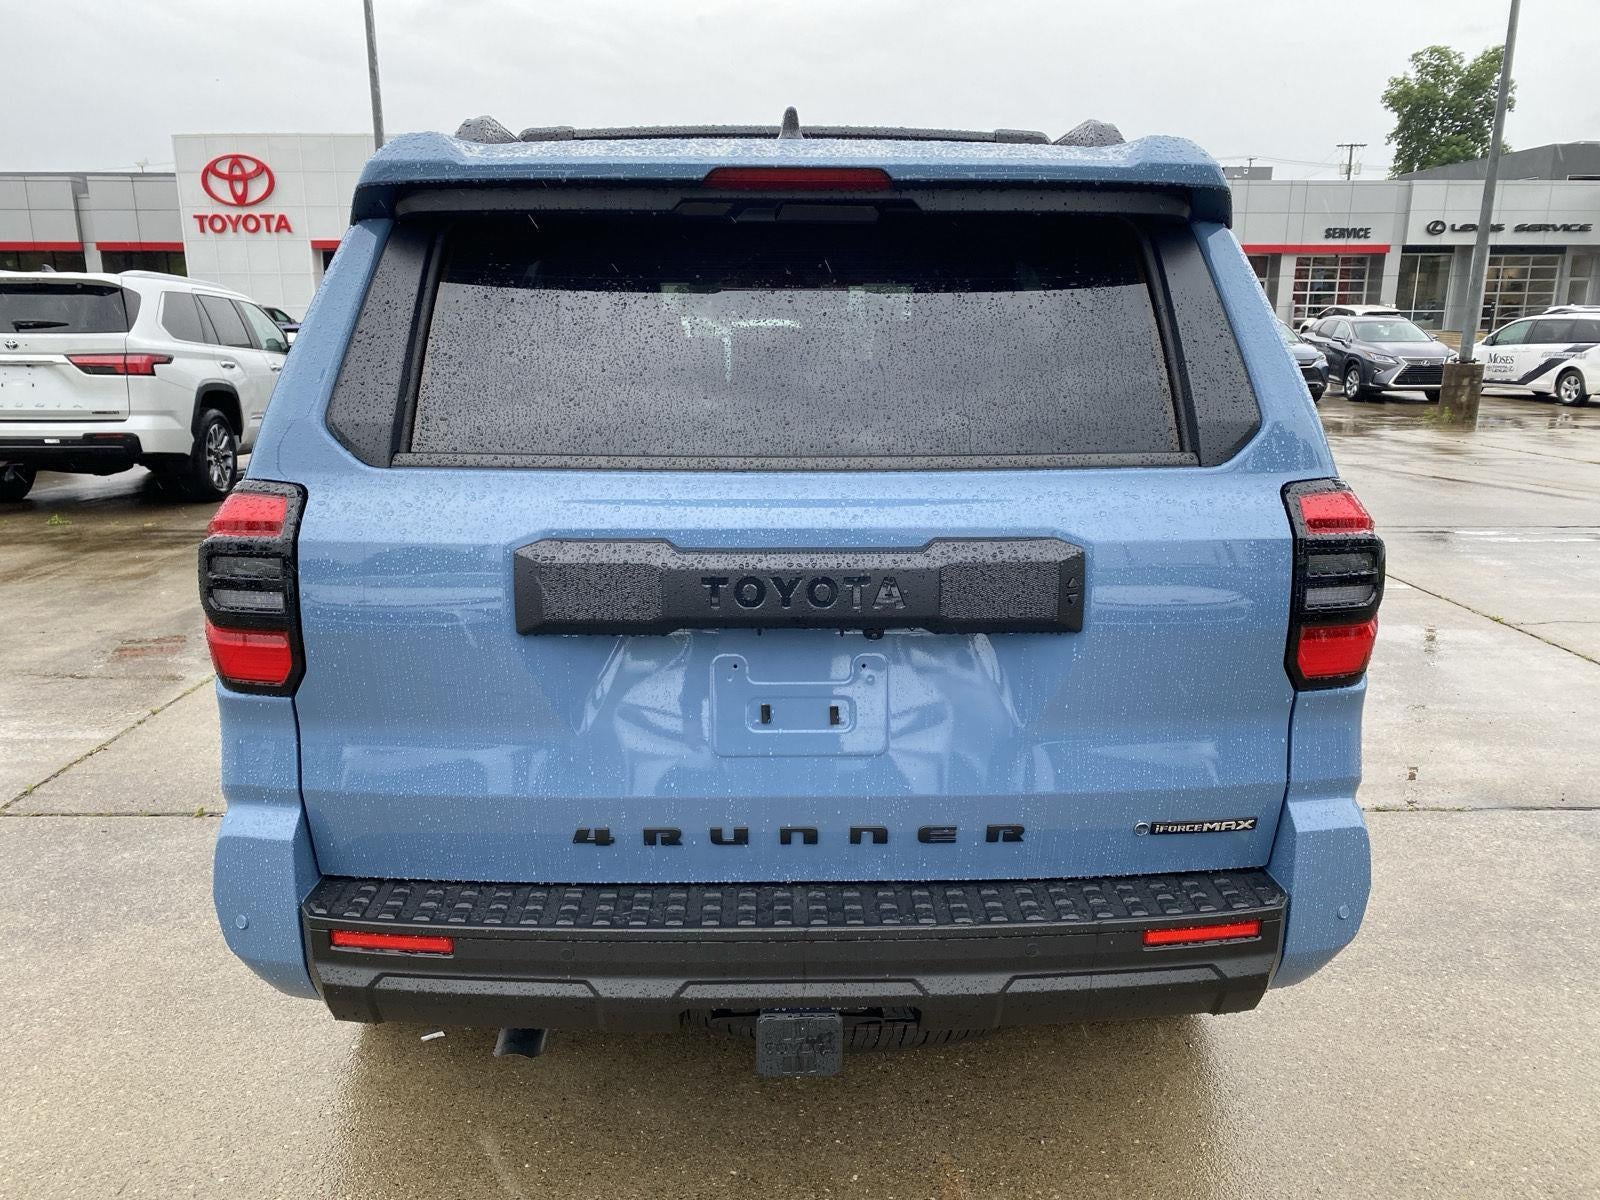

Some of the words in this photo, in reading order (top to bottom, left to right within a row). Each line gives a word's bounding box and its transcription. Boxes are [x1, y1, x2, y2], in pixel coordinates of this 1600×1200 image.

[193, 213, 292, 233] TOYOTA
[1324, 227, 1371, 239] SERVICE
[1513, 223, 1593, 232] SERVICE
[701, 576, 906, 609] TOYOTA
[572, 824, 1025, 846] 4RUNNER
